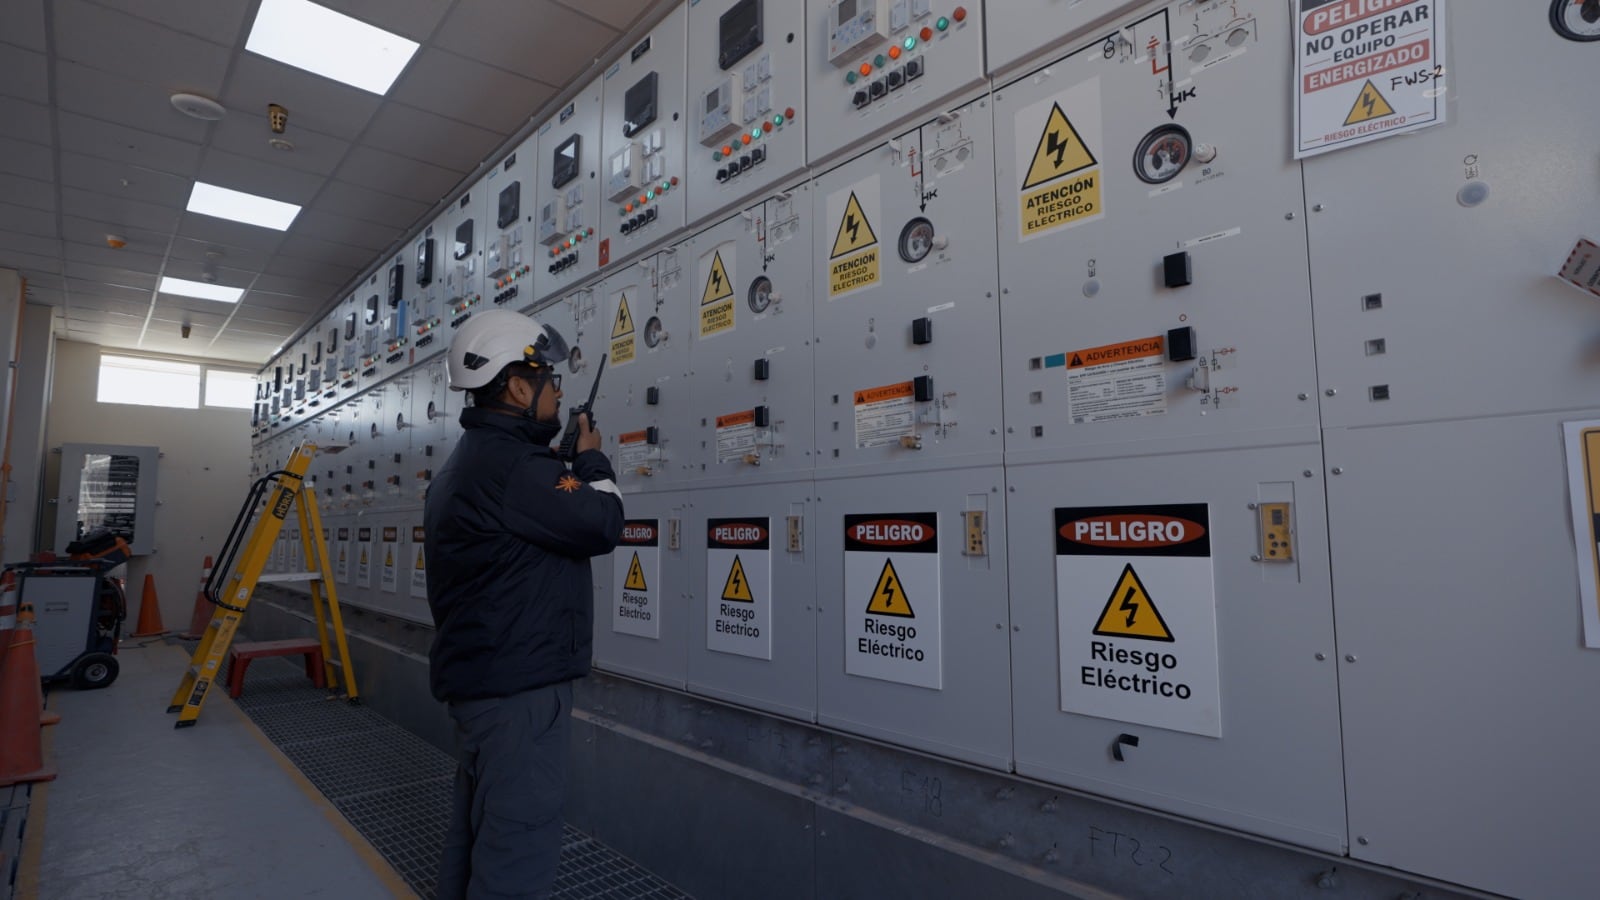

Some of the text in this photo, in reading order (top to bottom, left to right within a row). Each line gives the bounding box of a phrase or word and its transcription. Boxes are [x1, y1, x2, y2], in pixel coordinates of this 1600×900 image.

[1313, 0, 1404, 31] PELIG
[1306, 4, 1429, 56] NO OPERAR
[1333, 34, 1396, 63] EQUIPO
[1309, 44, 1424, 90] ENERGIZADO
[1390, 64, 1444, 91] FWS-2
[1324, 128, 1356, 143] RIESGO
[1027, 202, 1093, 230] ELECTRICO
[1037, 195, 1081, 216] RIESGO
[833, 272, 875, 292] ELECTRICO
[840, 266, 867, 281] RIESGO
[1086, 341, 1160, 361] ADVERTENCIA
[715, 527, 760, 541] PELIGRO
[856, 524, 923, 541] PELIGRO
[1075, 520, 1184, 542] PELIGRO
[622, 592, 648, 607] Riesgo
[720, 603, 755, 622] Riesgo
[715, 619, 760, 638] Eléctrico
[865, 618, 916, 641] Riesgo
[858, 638, 924, 661] Eléctrico
[1091, 641, 1177, 672] Riesgo
[1081, 666, 1191, 699] Eléctrico
